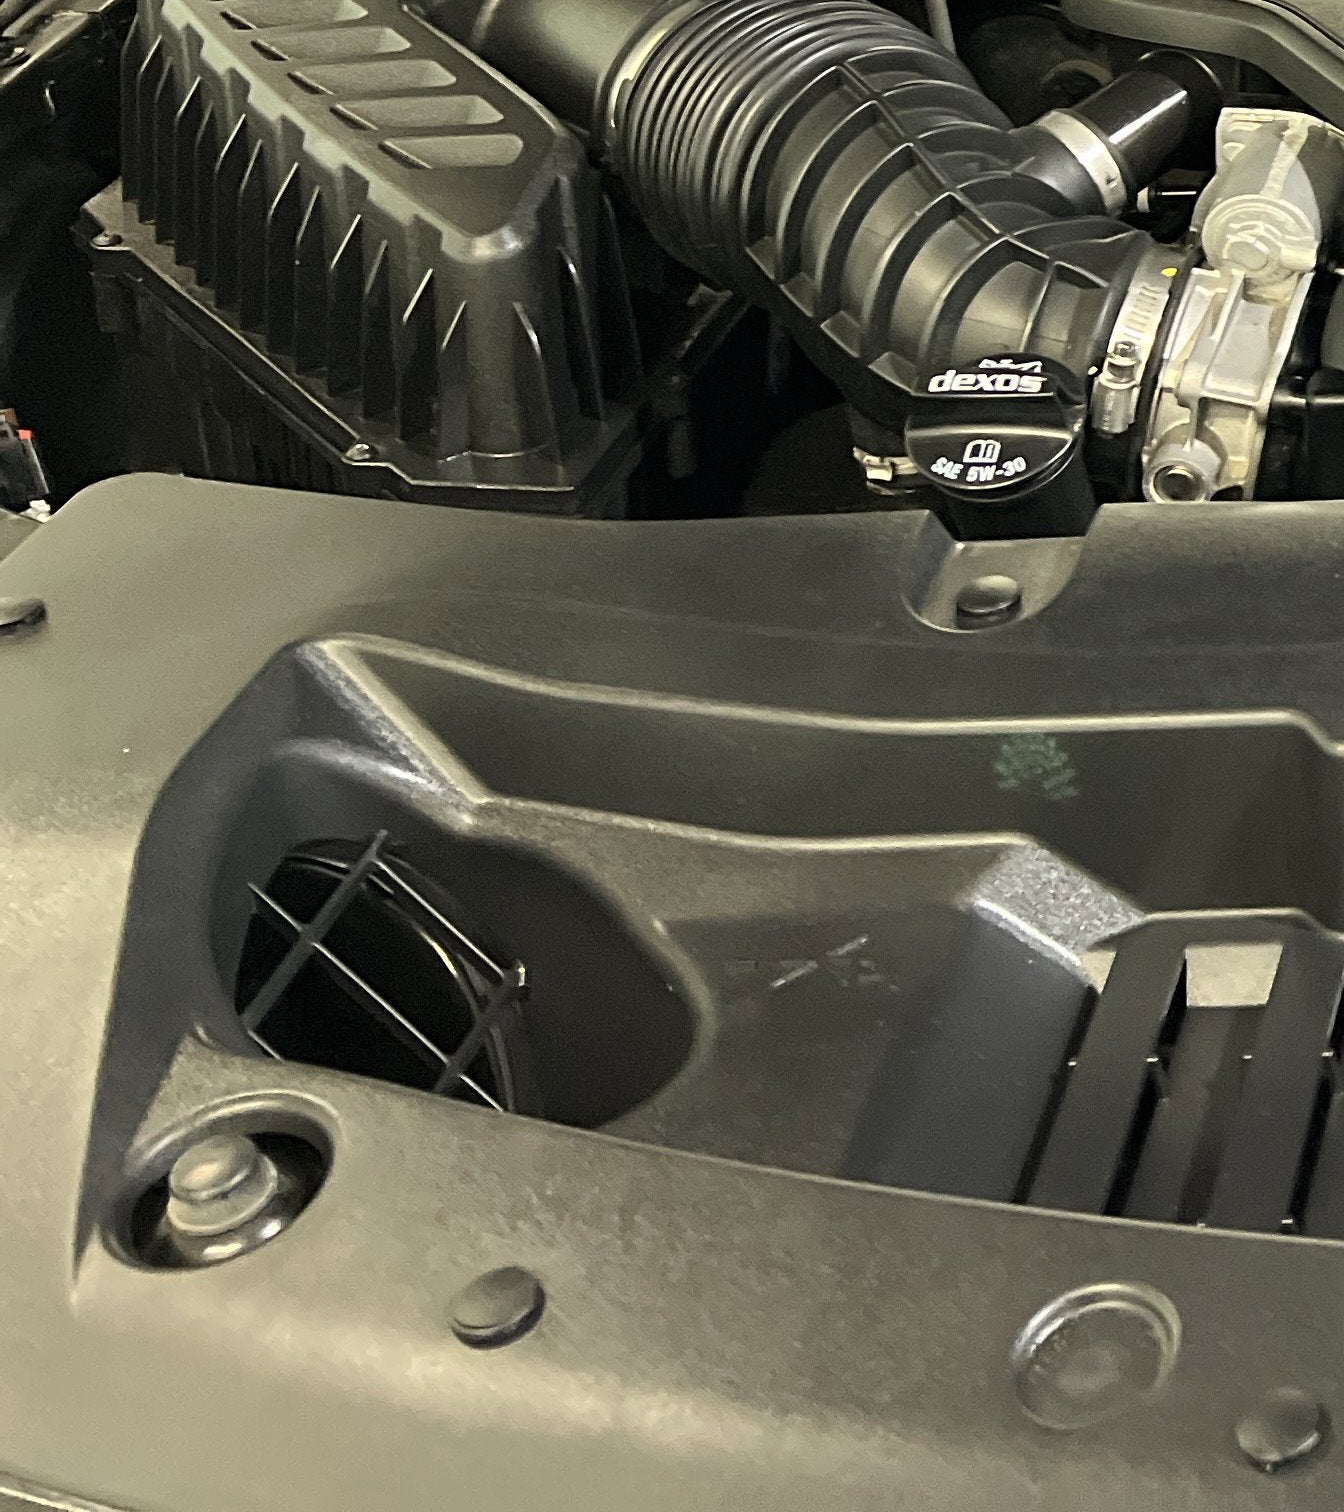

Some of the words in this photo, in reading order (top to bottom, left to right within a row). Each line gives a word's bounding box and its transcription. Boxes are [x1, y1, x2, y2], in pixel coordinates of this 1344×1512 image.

[929, 369, 1047, 393] dexos
[931, 457, 964, 480] SAE
[965, 457, 1026, 482] 5W-30
